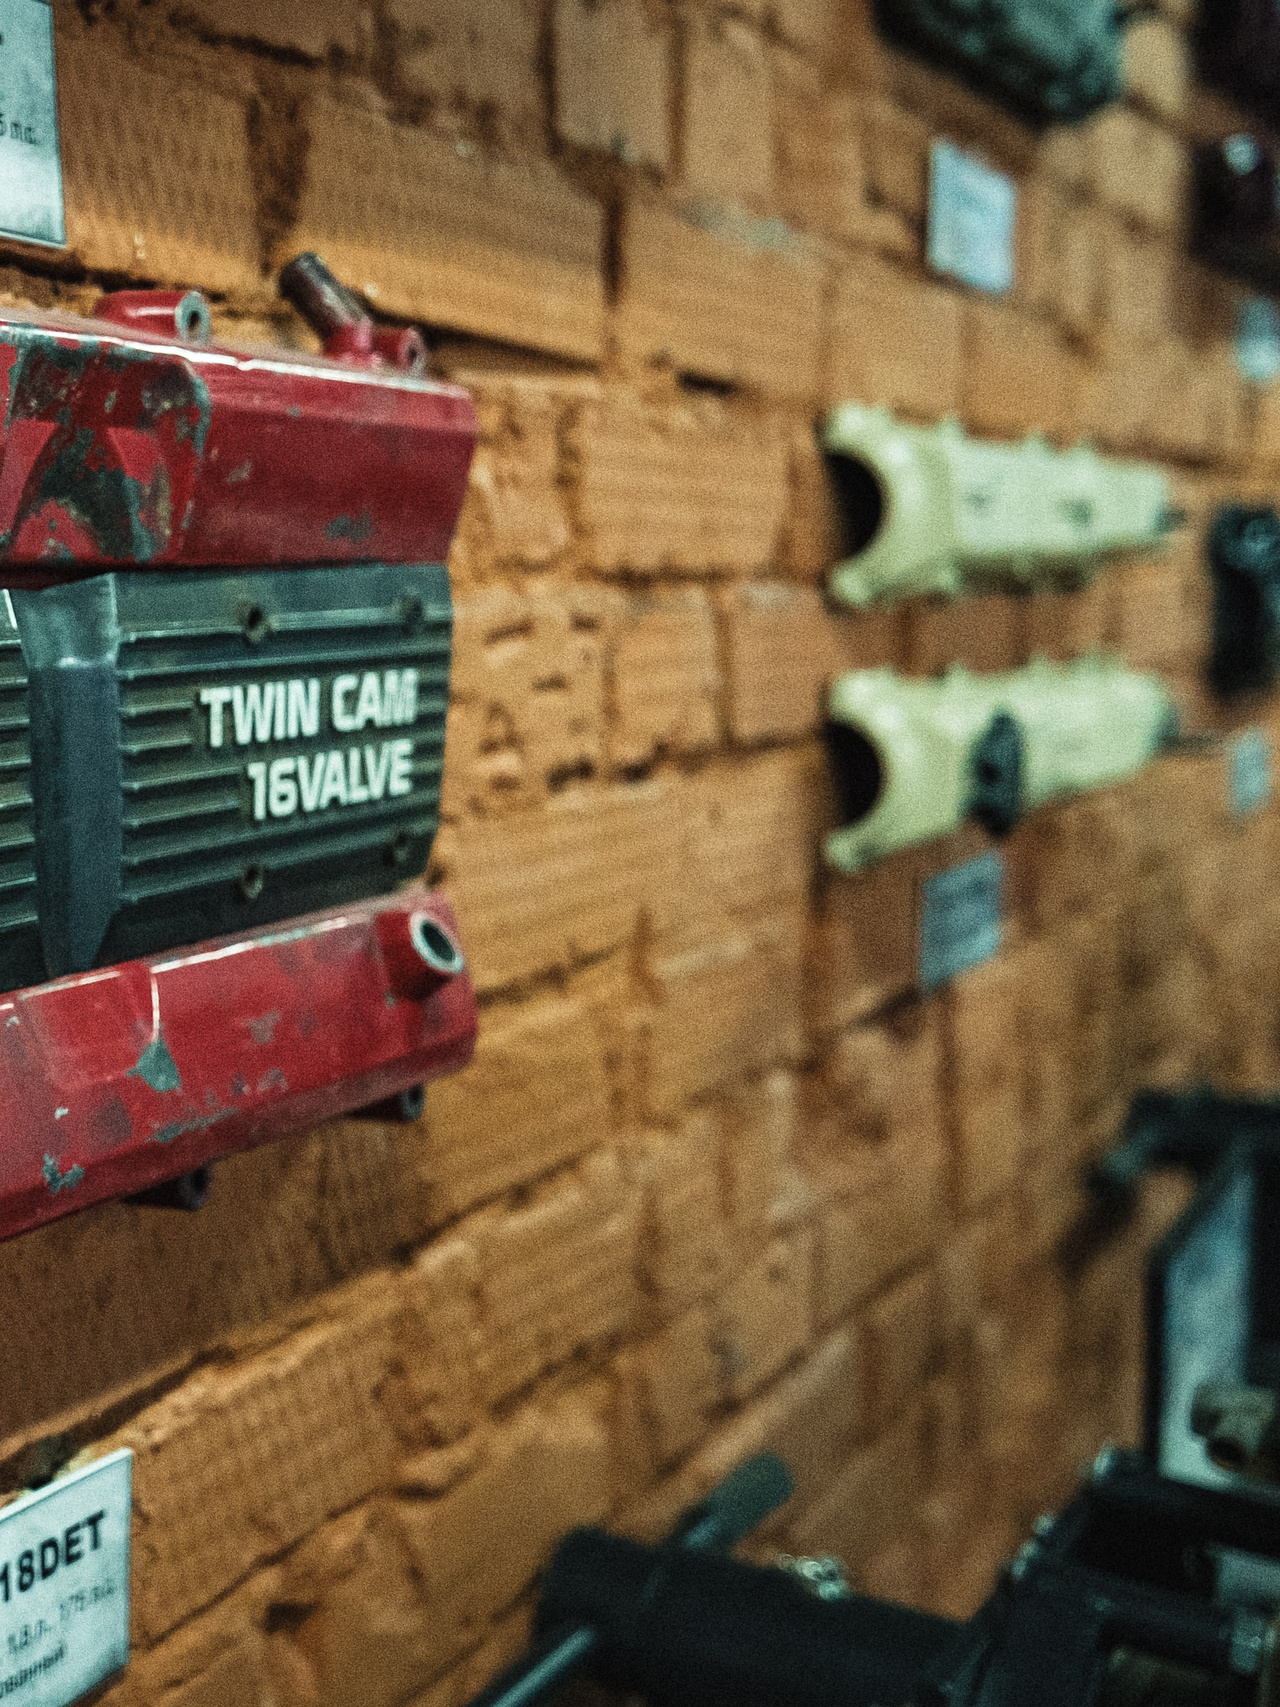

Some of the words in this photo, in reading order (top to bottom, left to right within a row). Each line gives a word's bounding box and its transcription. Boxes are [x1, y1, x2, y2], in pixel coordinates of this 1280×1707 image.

[199, 676, 321, 748] TWIN
[331, 668, 420, 733] CAM
[246, 738, 416, 822] 16VALVE
